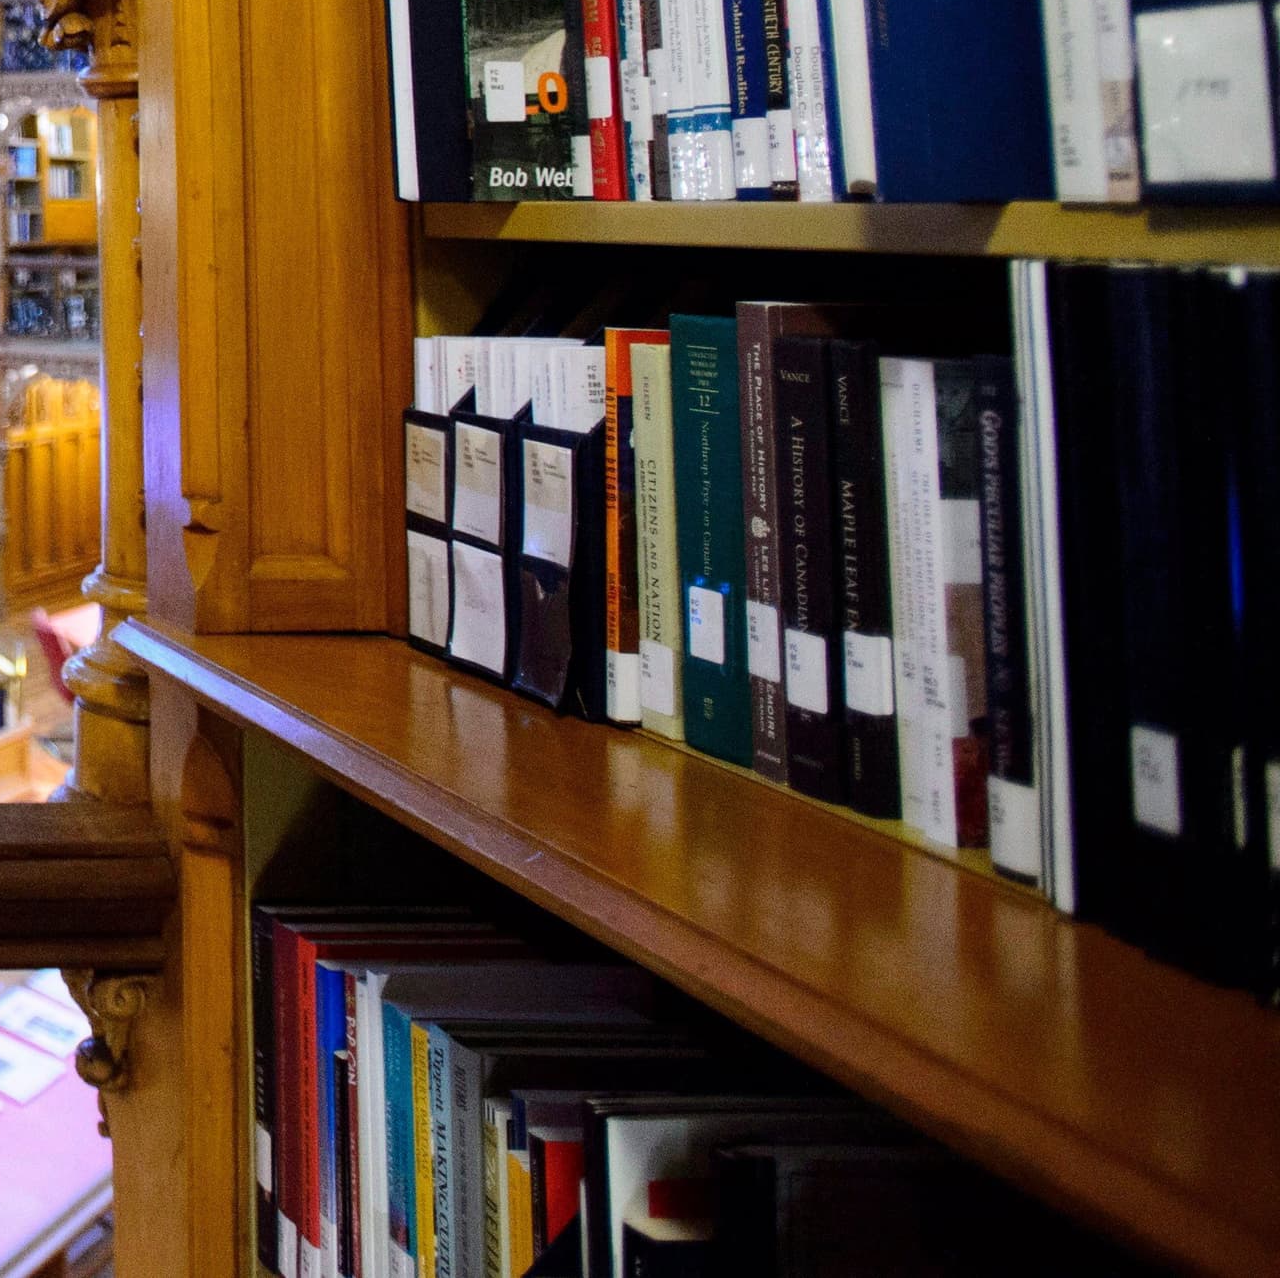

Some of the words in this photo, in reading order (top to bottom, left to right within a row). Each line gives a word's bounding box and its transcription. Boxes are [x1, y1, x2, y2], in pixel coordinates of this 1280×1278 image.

[734, 55, 748, 115] Realities
[766, 44, 782, 96] CENTURY
[794, 46, 806, 98] Douglas
[810, 46, 823, 99] Douglas
[489, 167, 528, 188] Bob
[587, 364, 597, 372] FC
[752, 342, 761, 373] THE
[779, 368, 812, 384] VANCE
[589, 389, 605, 397] 2017
[605, 386, 618, 445] NATIONAL
[642, 376, 652, 422] FRIESEN
[698, 394, 712, 408] 12
[754, 375, 763, 421] PLACE
[836, 375, 850, 424] VANCE
[912, 383, 924, 455] DUCHARME
[700, 419, 712, 477] Northrop
[756, 425, 764, 445] OF
[790, 415, 803, 429] A
[605, 450, 618, 510] DREAMS
[699, 480, 711, 511] Frye
[757, 449, 767, 512] HISTORY
[791, 435, 807, 507] HISTORY
[646, 459, 658, 536] CITIZENS
[841, 480, 858, 549] MAPLE
[794, 515, 806, 538] OF
[650, 543, 658, 571] AND
[701, 530, 713, 577] Canada
[761, 545, 770, 572] LES
[651, 577, 662, 643] NATION
[795, 544, 809, 634] CANADIAN
[844, 556, 859, 617] LEAF
[433, 1046, 447, 1114] Tippett
[434, 1122, 449, 1203] MAKING
